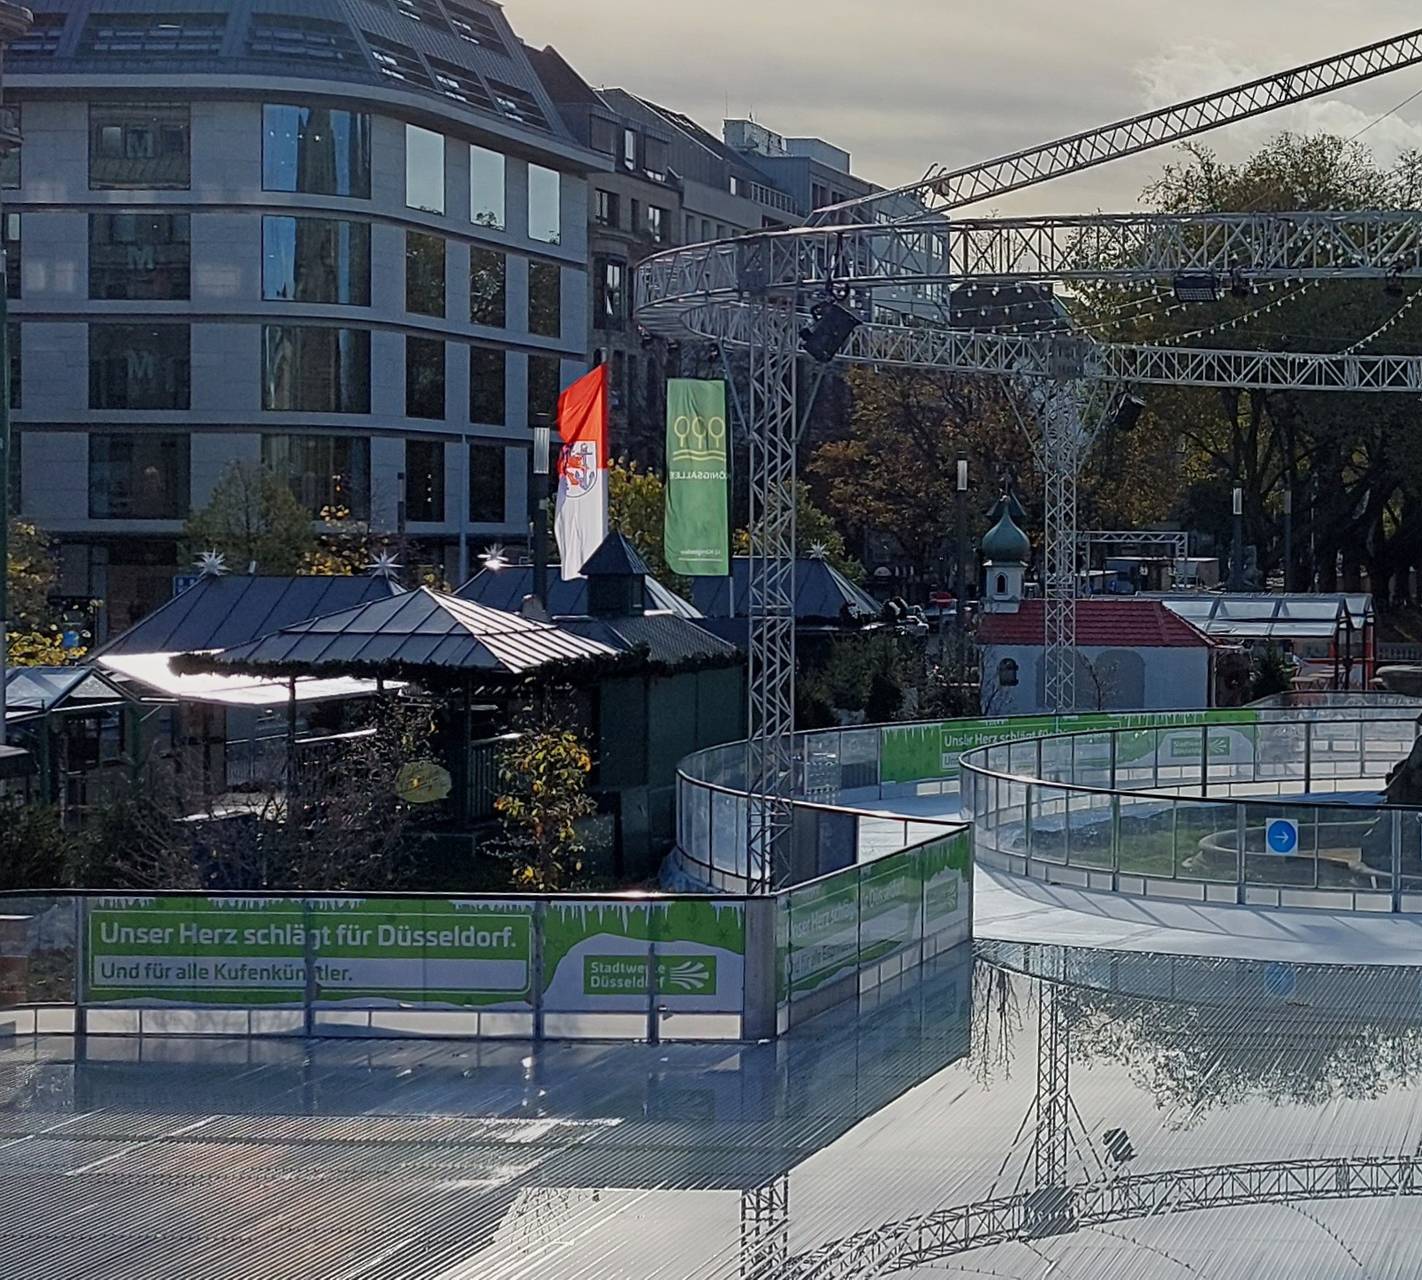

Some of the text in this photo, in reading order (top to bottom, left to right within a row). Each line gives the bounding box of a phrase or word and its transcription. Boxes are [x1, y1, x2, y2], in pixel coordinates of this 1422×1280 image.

[100, 921, 173, 944] Unser
[179, 922, 238, 945] Herz
[336, 924, 372, 946] für
[378, 924, 516, 948] Düsseldorf.
[101, 962, 352, 982] Und für alle Kufenküntler.
